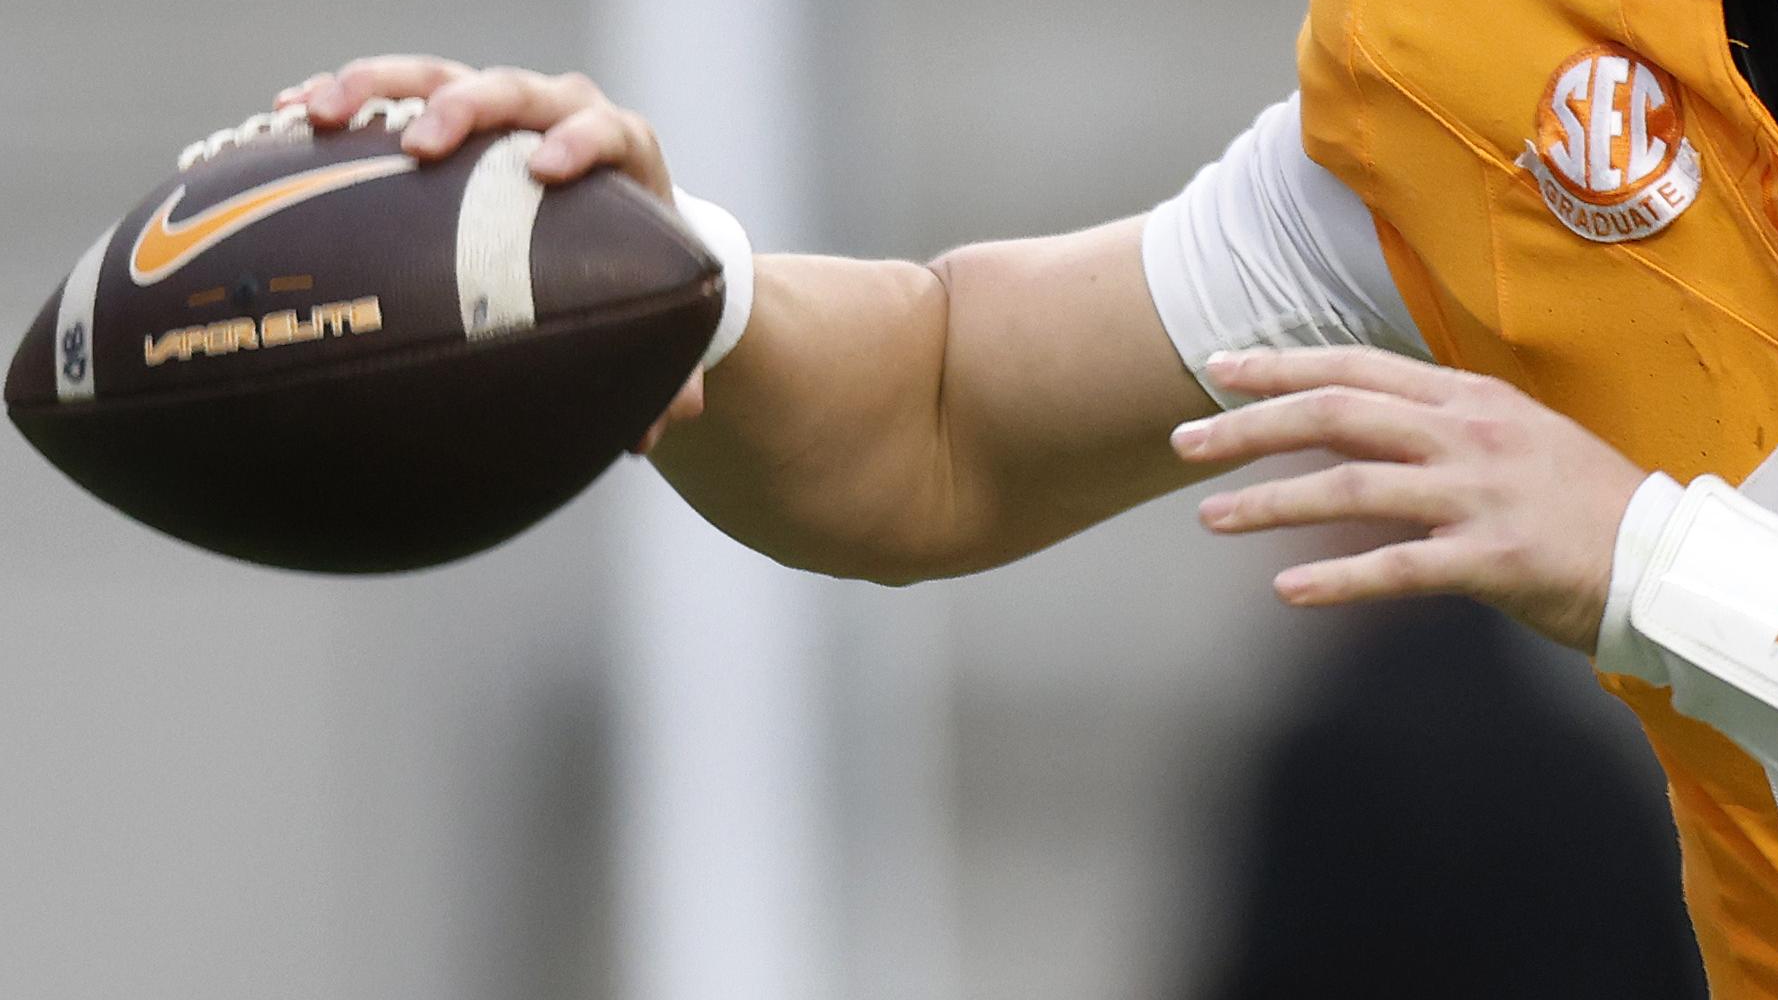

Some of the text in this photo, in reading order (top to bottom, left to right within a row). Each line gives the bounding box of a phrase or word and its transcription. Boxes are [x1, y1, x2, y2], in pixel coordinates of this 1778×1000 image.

[1550, 55, 1668, 191] SEC
[1543, 178, 1686, 237] GRADUATE
[144, 295, 383, 367] VAPOR ELITE
